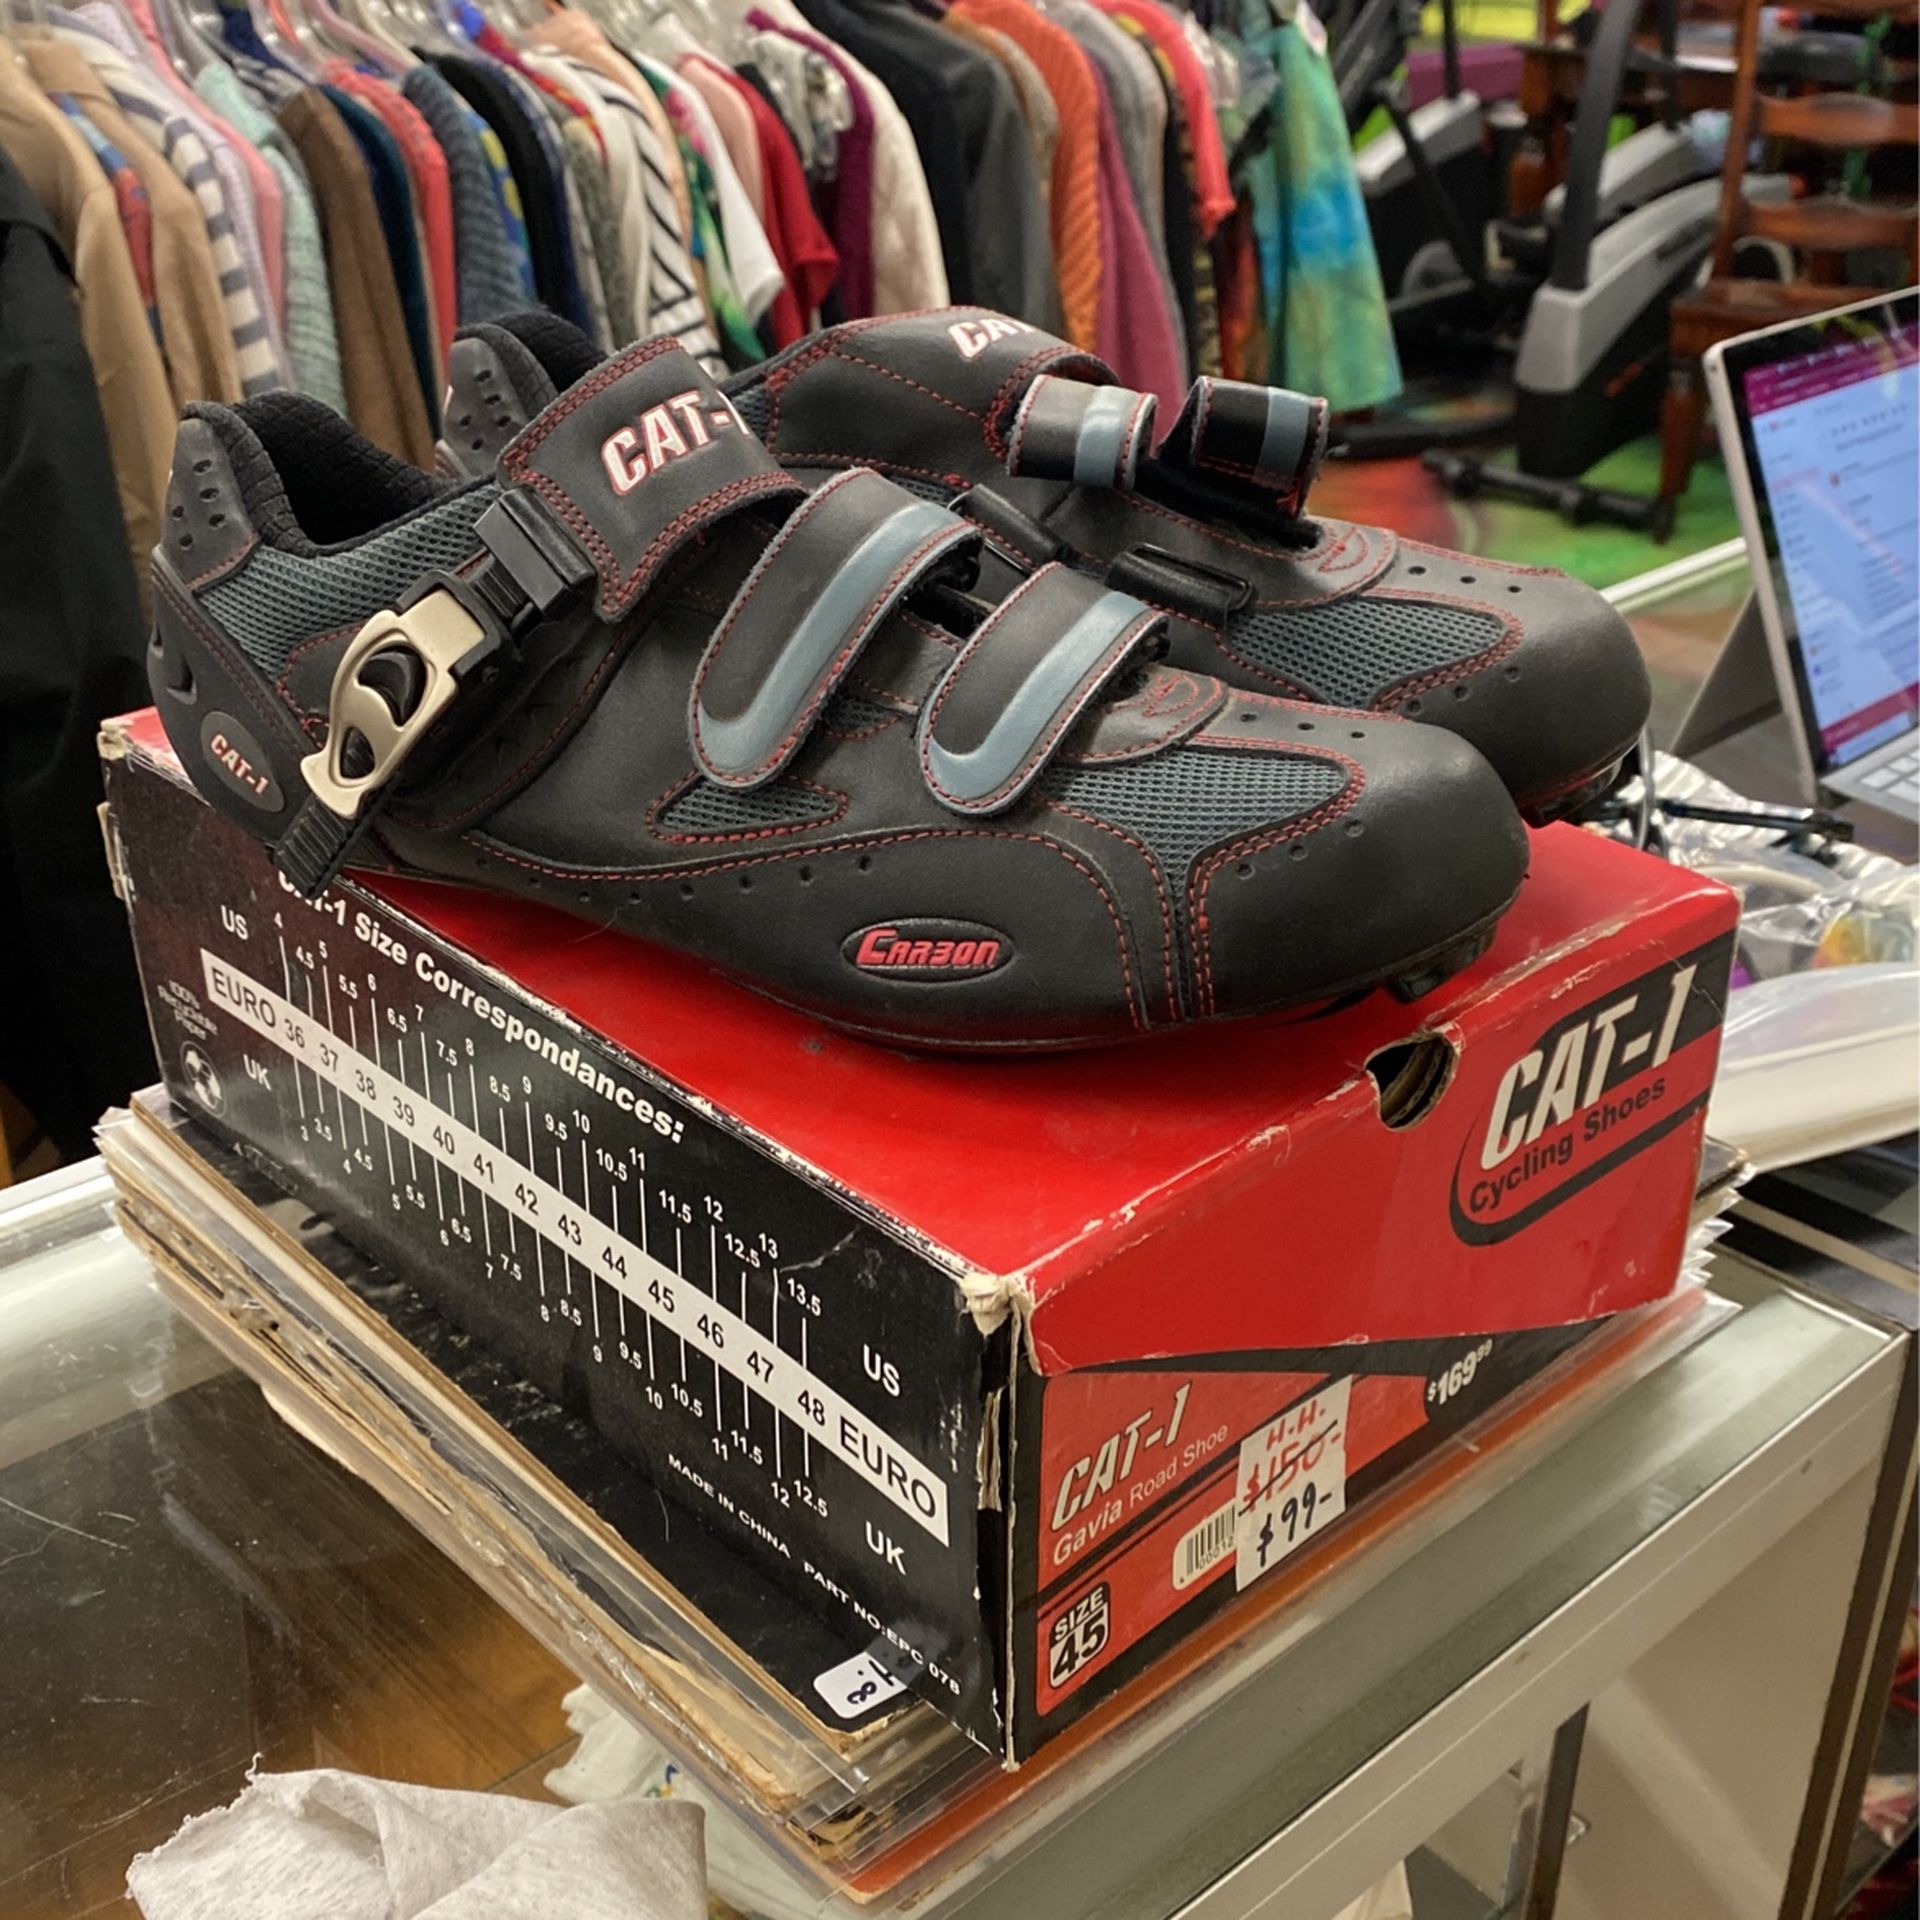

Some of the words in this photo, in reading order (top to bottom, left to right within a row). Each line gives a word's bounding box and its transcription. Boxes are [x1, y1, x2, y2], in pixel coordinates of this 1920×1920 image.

[210, 733, 269, 794] CAT-1
[354, 912, 408, 965] Size
[415, 952, 685, 1144] Correspondances:
[1481, 963, 1698, 1171] CAT-1
[221, 904, 249, 940] US
[295, 946, 315, 969] 4.5
[319, 940, 329, 959] 5
[339, 974, 358, 999] 5.5
[367, 973, 377, 991] 6
[387, 1007, 408, 1033] 6.5
[415, 1004, 424, 1021] 7
[436, 1039, 458, 1066] 7.5
[465, 1038, 475, 1056] 8
[489, 1076, 511, 1102] 8.5
[522, 1076, 532, 1094] 9
[544, 1113, 568, 1140] 9.5
[572, 1109, 590, 1133] 10
[596, 1147, 628, 1181] 10.5
[629, 1147, 645, 1171] 11
[658, 1189, 692, 1223] 11.5
[703, 1196, 723, 1222] 12
[724, 1233, 761, 1269] 12.5
[758, 1232, 779, 1260] 13
[787, 1277, 822, 1316] 13.5
[863, 1343, 901, 1397] US
[1468, 1132, 1574, 1213] Cycling
[1583, 1078, 1666, 1141] Shoes
[211, 966, 277, 1028] EURO
[284, 1018, 305, 1048] 36
[319, 1043, 339, 1073] 37
[355, 1069, 376, 1100] 38
[392, 1096, 415, 1127] 39
[432, 1125, 455, 1155] 40
[473, 1153, 495, 1183] 41
[514, 1183, 539, 1216] 42
[557, 1214, 581, 1246] 43
[602, 1246, 628, 1279] 44
[647, 1279, 675, 1313] 45
[697, 1314, 724, 1348] 46
[746, 1350, 774, 1383] 47
[797, 1390, 826, 1426] 48
[840, 1415, 937, 1518] EURO
[243, 1053, 272, 1091] UK
[391, 1193, 401, 1211] 5
[405, 1184, 426, 1209] 5.5
[440, 1229, 450, 1246] 6
[451, 1217, 472, 1243] 6.5
[485, 1261, 494, 1279] 7
[500, 1253, 521, 1281] 7.5
[540, 1304, 550, 1323] 8
[560, 1299, 582, 1327] 8.5
[592, 1344, 603, 1363] 9
[619, 1341, 643, 1370] 9.5
[645, 1386, 664, 1410] 10
[670, 1383, 704, 1418] 10.5
[711, 1437, 728, 1461] 11
[730, 1429, 763, 1466] 11.5
[771, 1481, 791, 1508] 12
[793, 1479, 829, 1518] 12.5
[865, 1520, 907, 1576] UK
[669, 1453, 715, 1499] MADE
[718, 1492, 735, 1513] IN
[739, 1510, 792, 1560] CHINA
[803, 1560, 850, 1604] PART
[1051, 1380, 1192, 1531] CAT-1
[1053, 1499, 1123, 1565] Gavia
[1129, 1456, 1178, 1509] Road
[1182, 1424, 1229, 1468] Shoe
[1052, 1606, 1107, 1680] 45
[1054, 1585, 1105, 1641] SIZE
